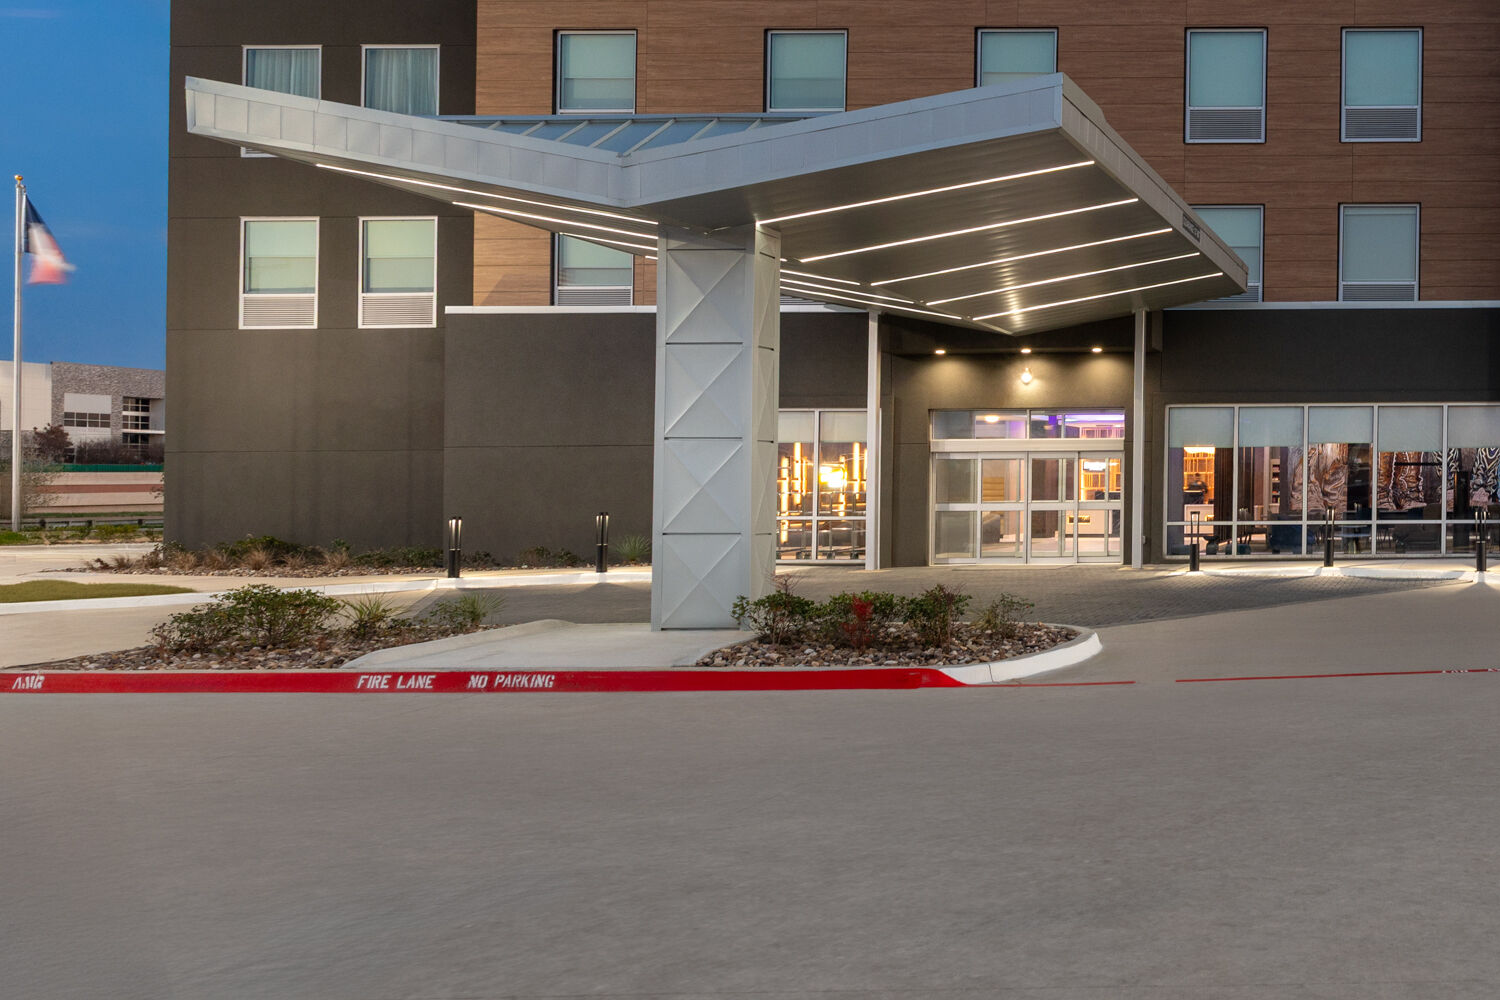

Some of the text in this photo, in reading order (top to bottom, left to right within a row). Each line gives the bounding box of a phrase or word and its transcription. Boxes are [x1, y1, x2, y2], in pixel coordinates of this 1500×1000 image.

[356, 673, 556, 690] FIRE LANE NO PARKING
